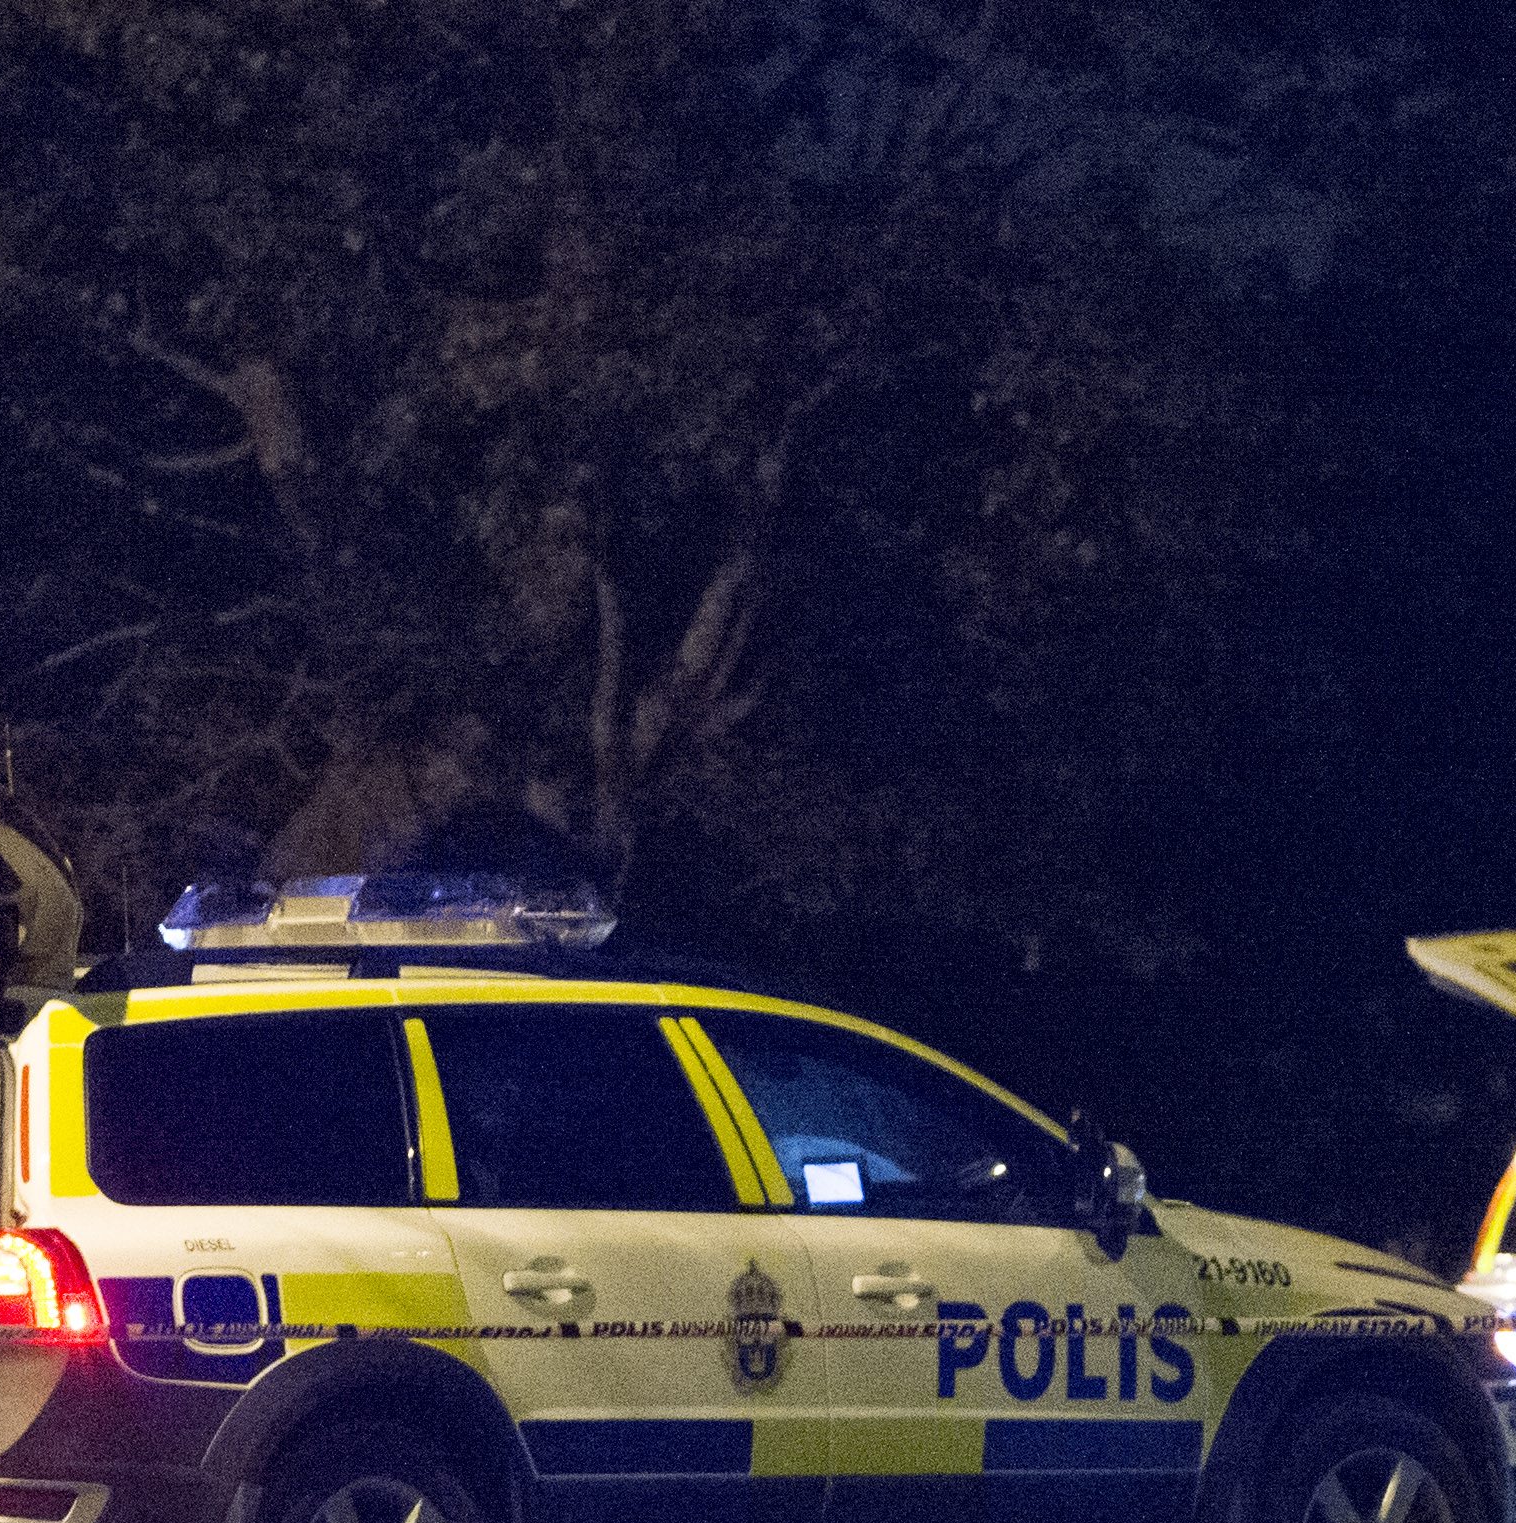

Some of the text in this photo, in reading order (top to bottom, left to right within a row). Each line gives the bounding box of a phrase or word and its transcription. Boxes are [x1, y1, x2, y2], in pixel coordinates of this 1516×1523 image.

[184, 1238, 236, 1252] DIESEL
[1192, 1254, 1291, 1287] 21-9160
[592, 1321, 665, 1337] POLIS
[1357, 1319, 1424, 1336] POLIS
[938, 1300, 1195, 1402] POLIS
